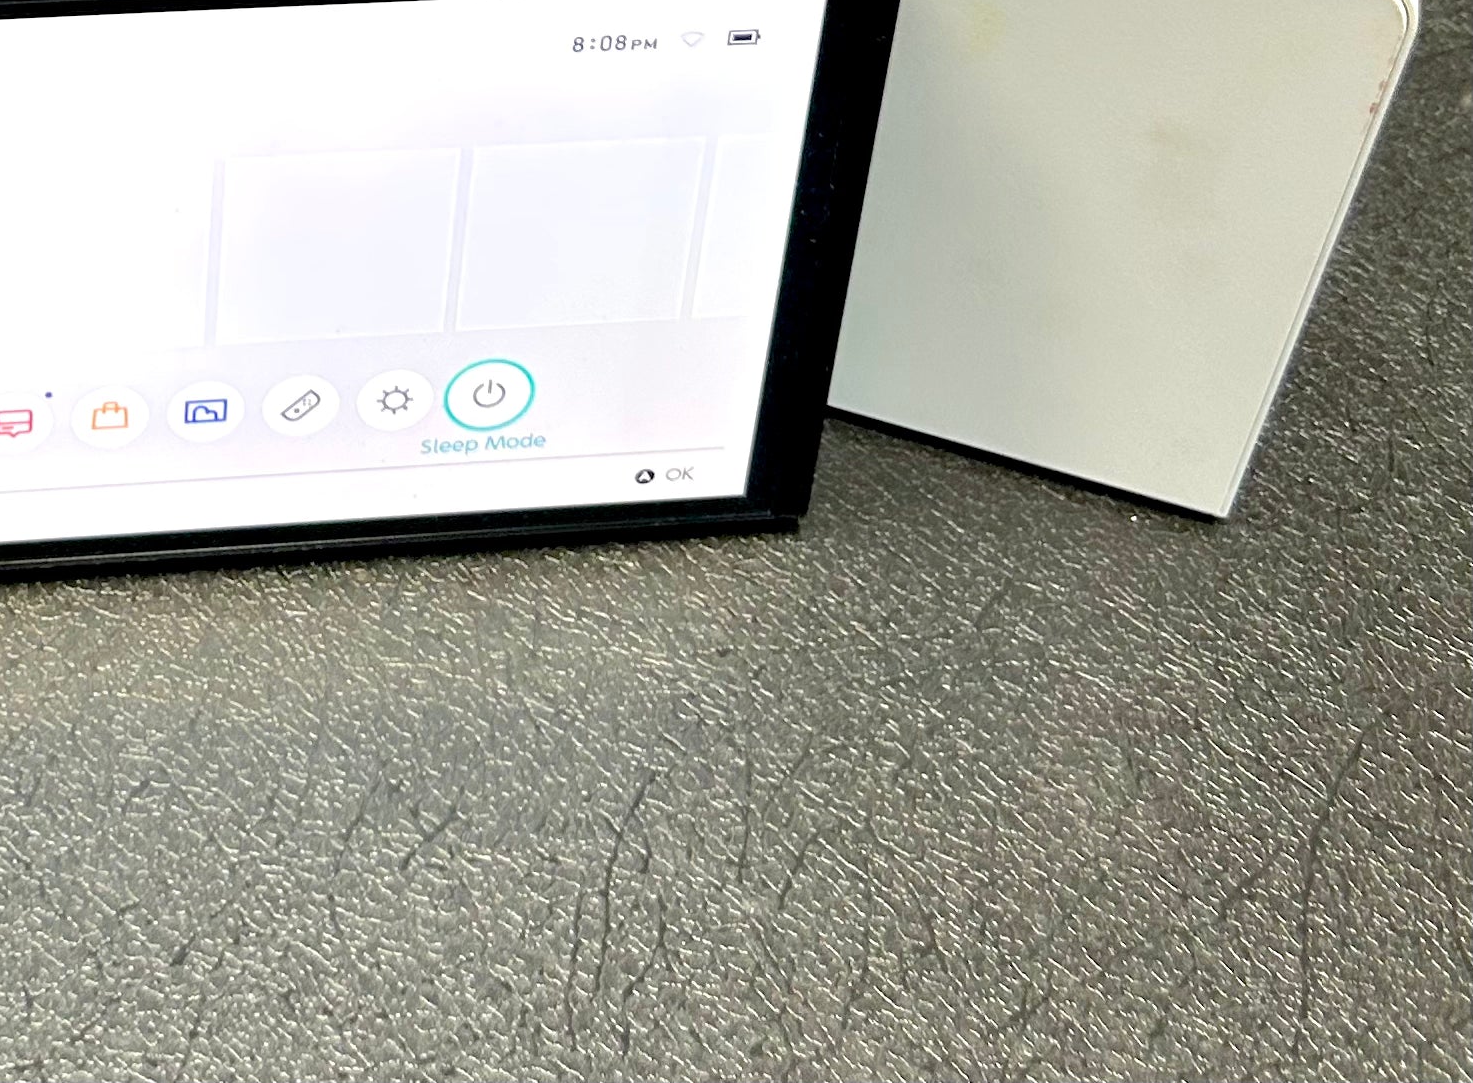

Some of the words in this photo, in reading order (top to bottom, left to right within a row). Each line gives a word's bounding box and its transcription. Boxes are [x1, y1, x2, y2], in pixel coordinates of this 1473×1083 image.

[572, 35, 627, 52] 8:08
[631, 38, 657, 50] PM
[420, 438, 479, 456] Sleep
[484, 432, 546, 452] Mode
[665, 466, 695, 482] OK
